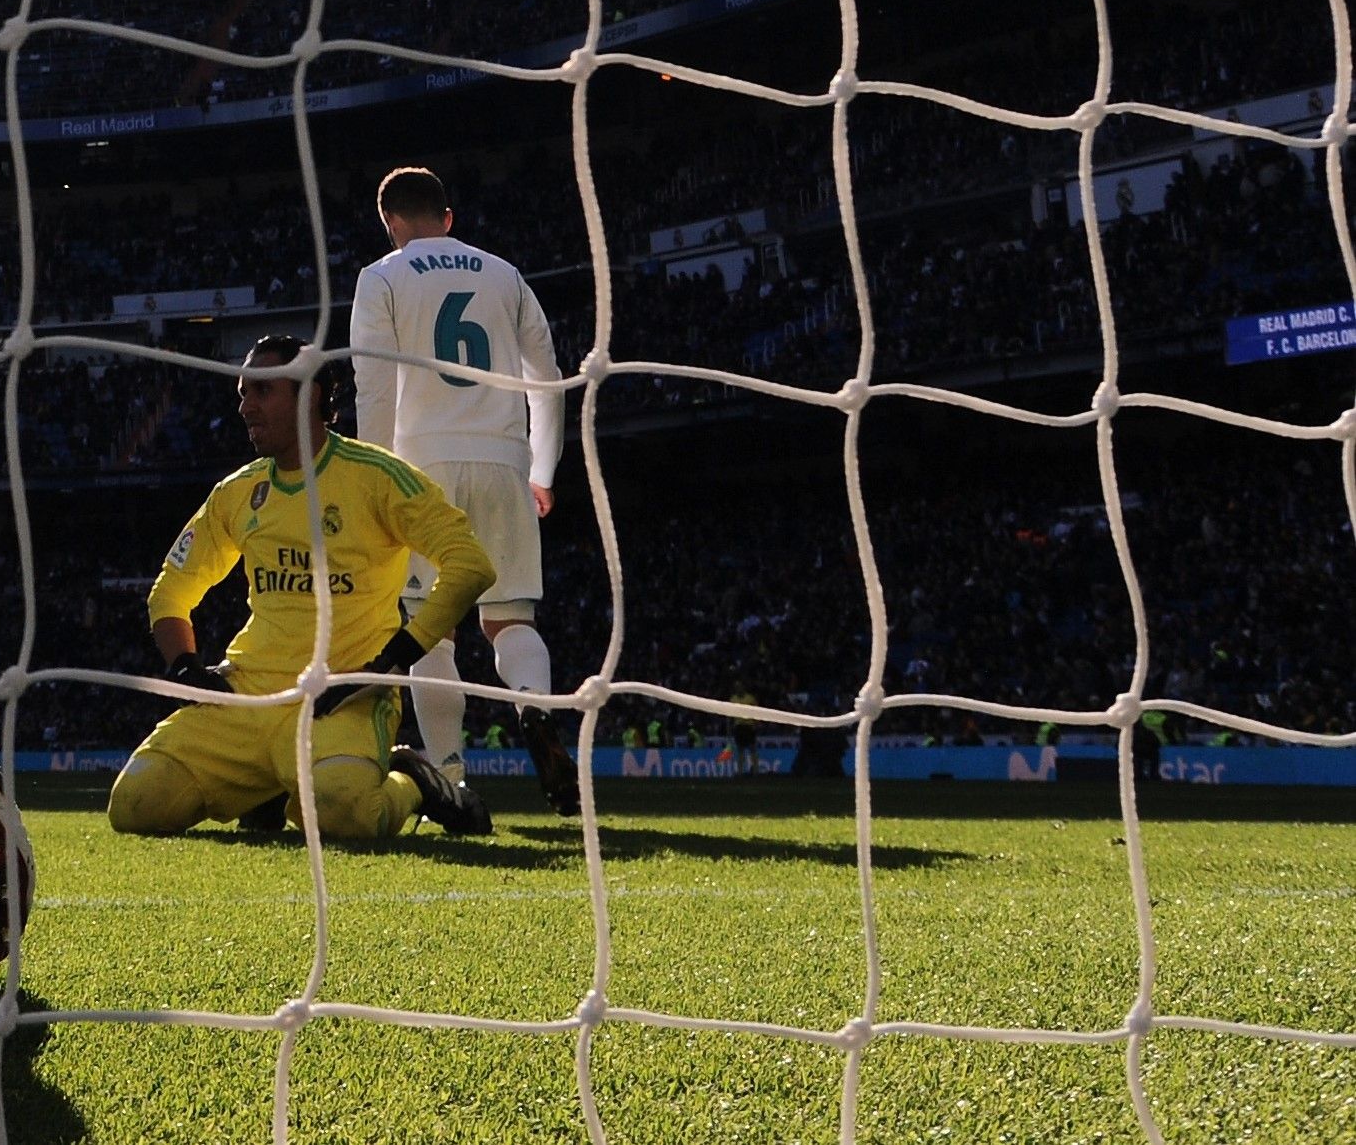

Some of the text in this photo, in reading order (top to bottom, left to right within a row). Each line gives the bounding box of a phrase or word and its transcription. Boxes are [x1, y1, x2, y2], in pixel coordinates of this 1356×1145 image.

[426, 70, 456, 90] Real
[61, 115, 154, 135] Real Madrid
[409, 254, 483, 275] NACHO
[1258, 306, 1352, 333] REAL MADRID C.
[434, 291, 491, 387] 6
[1266, 339, 1279, 356] F.
[278, 547, 311, 570] Fly
[254, 566, 355, 595] Emiraes
